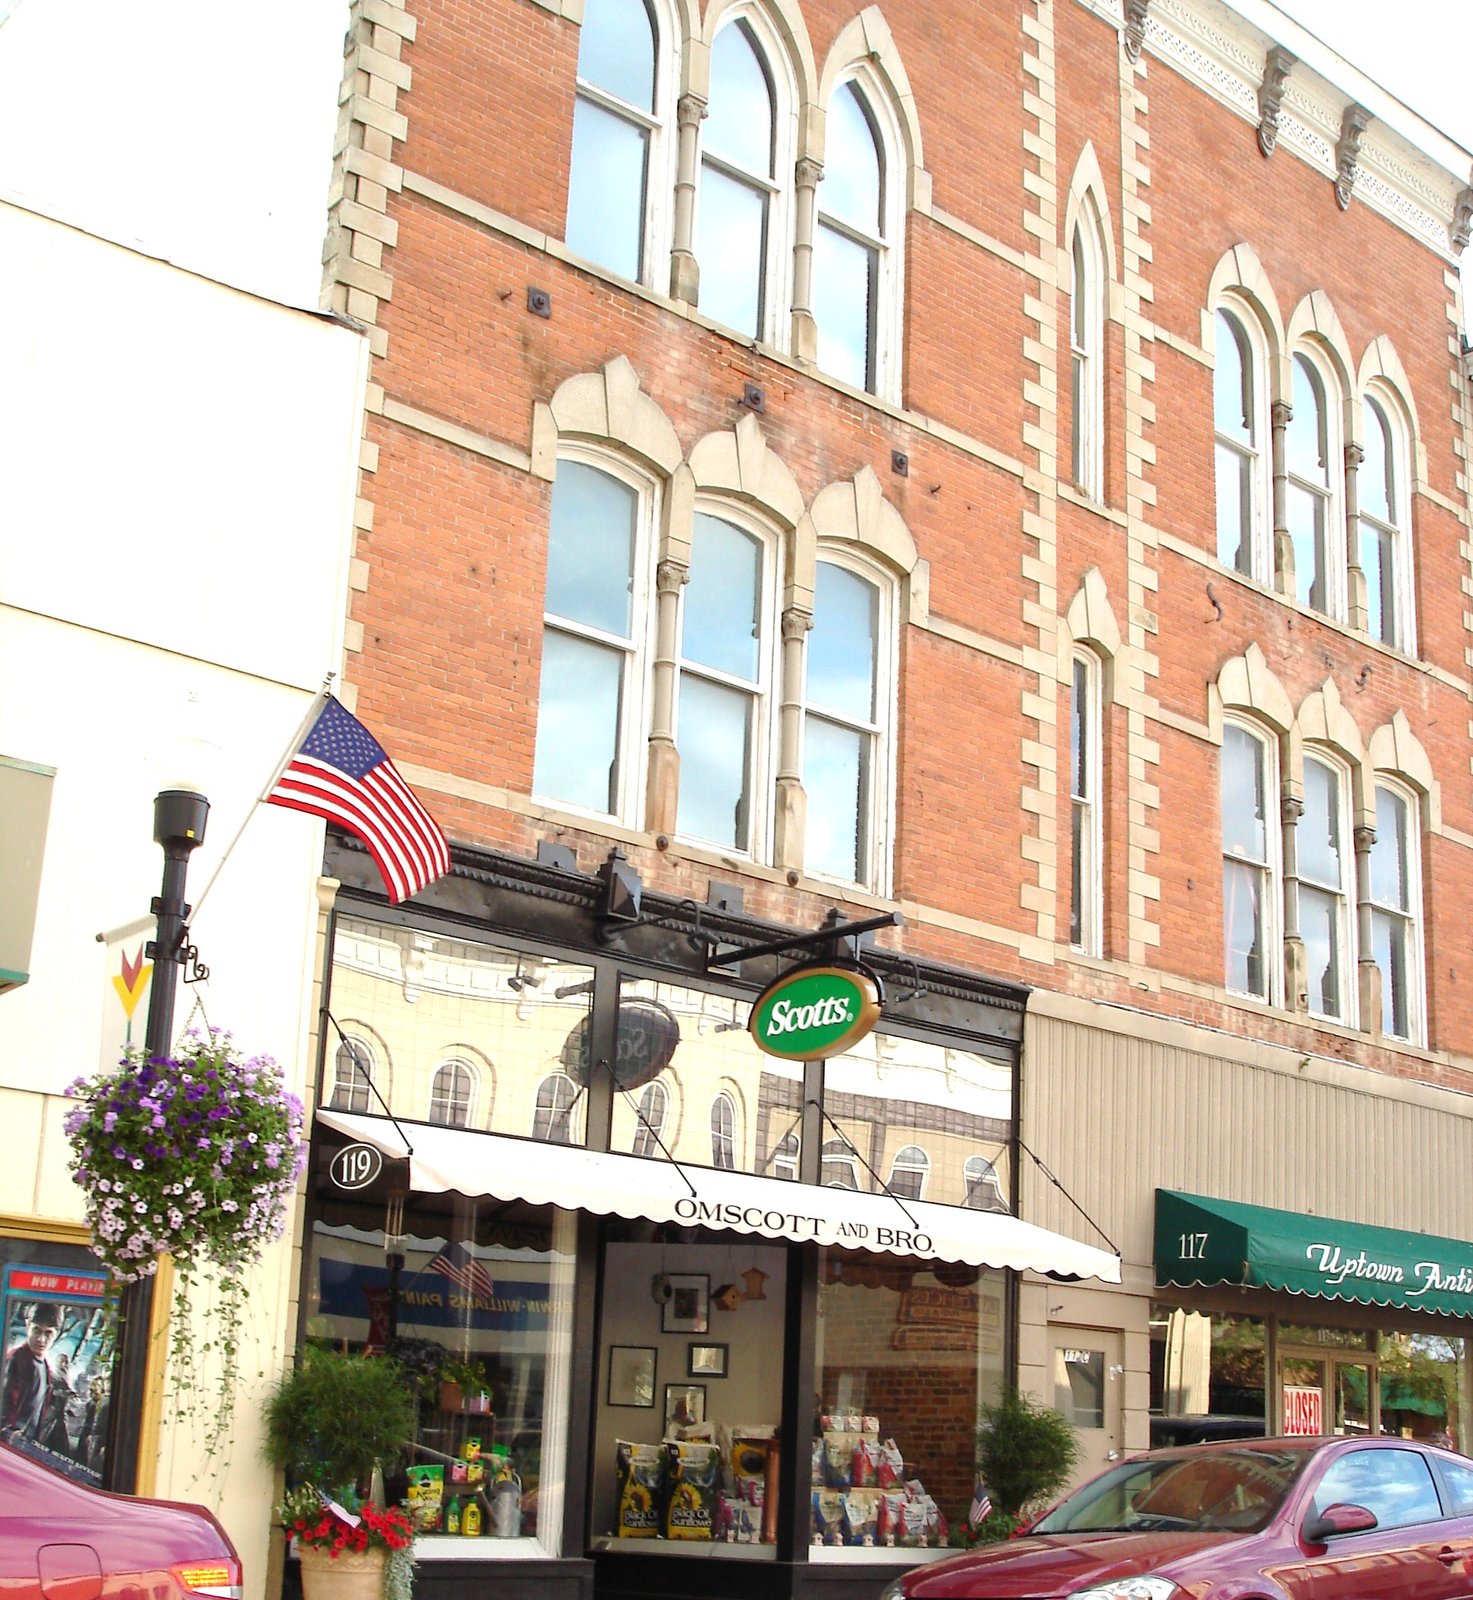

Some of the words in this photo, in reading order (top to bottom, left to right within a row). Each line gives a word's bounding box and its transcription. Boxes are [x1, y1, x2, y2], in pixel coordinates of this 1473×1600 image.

[766, 996, 850, 1036] Scotts
[342, 1150, 371, 1183] 119
[674, 1198, 826, 1236] OMSCOTT
[836, 1221, 869, 1239] AND
[876, 1227, 936, 1254] BRO.
[1178, 1233, 1208, 1259] 117
[1306, 1243, 1404, 1284] Uptown
[31, 1275, 59, 1288] NOW
[66, 1279, 106, 1293] PLAYIN
[1284, 1391, 1320, 1434] CLOSED
